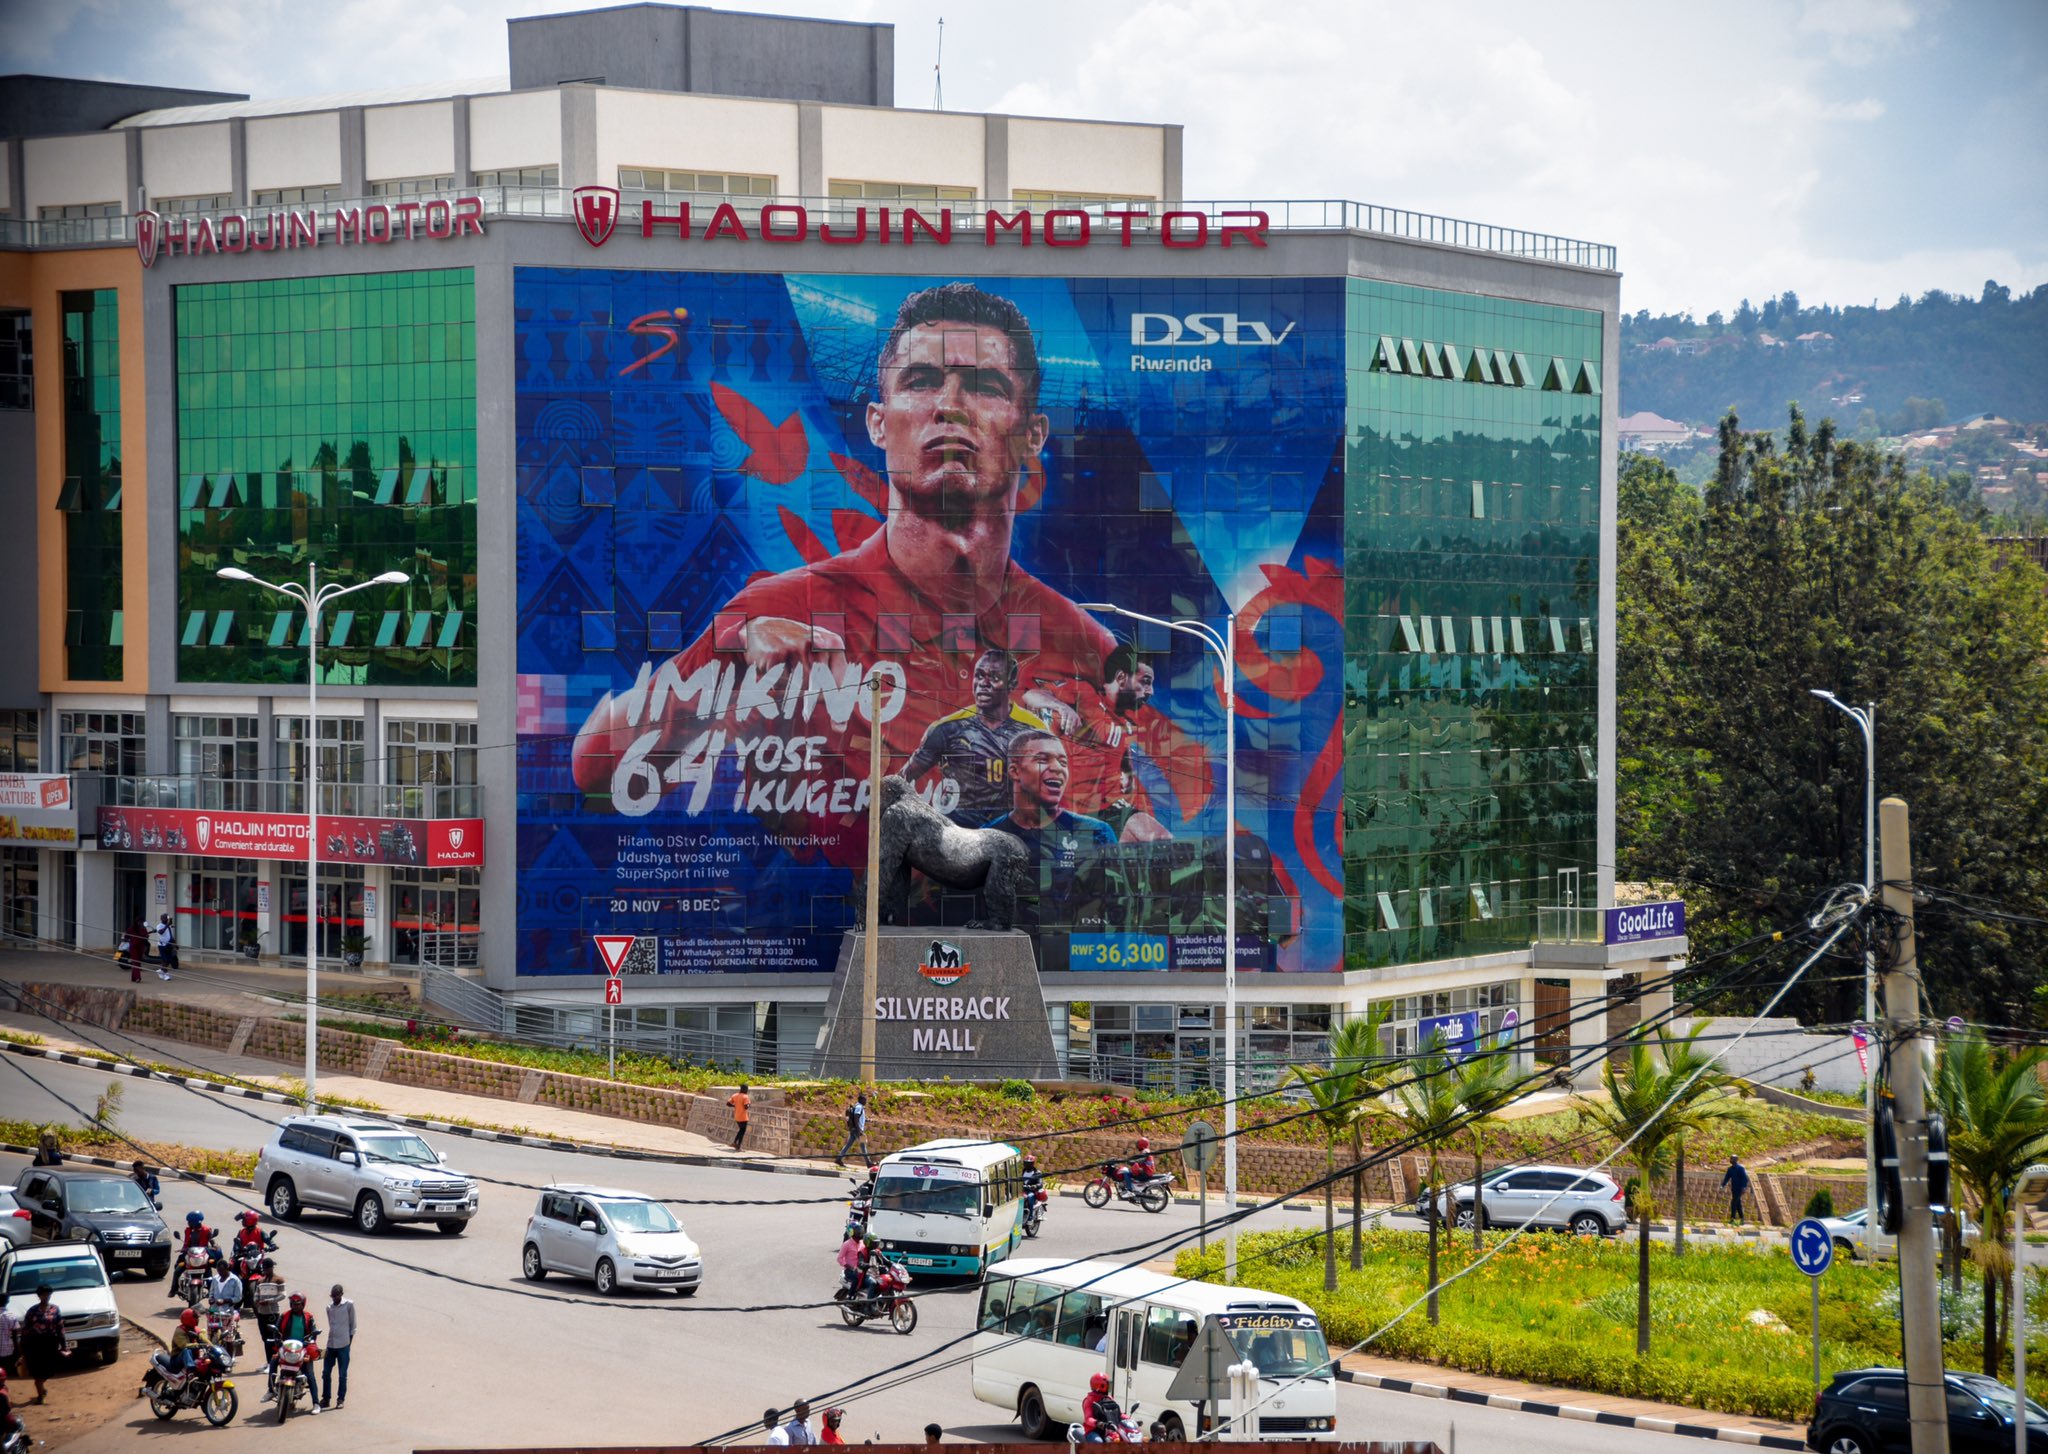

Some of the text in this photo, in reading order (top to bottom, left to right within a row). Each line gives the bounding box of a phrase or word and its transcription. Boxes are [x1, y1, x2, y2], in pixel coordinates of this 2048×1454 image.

[165, 209, 318, 257] HAOJIN
[335, 196, 485, 245] MOTOR
[641, 200, 951, 246] HAOJIN
[984, 209, 1270, 248] MOTOR
[1131, 313, 1296, 345] DStv
[1131, 355, 1212, 372] Rwanda
[627, 660, 906, 728] IMIKINO
[735, 735, 827, 773] YOSE
[611, 729, 727, 817] 64
[986, 758, 1003, 783] 10
[46, 789, 64, 804] OPEN
[214, 821, 264, 836] HAOJIN
[215, 839, 294, 853] Convenient and durable
[618, 834, 841, 849] Hitamo DStv Compact, Ntimucikwe!
[437, 851, 476, 859] HAOJIN
[617, 851, 741, 866] Udushya twose kuri
[616, 867, 730, 881] SuperSport ni live
[610, 900, 628, 912] 20
[632, 900, 661, 912] NOV
[677, 899, 690, 911] 18
[693, 899, 721, 911] DEC
[1618, 905, 1674, 934] GoodLife
[787, 938, 806, 946] 1111
[1175, 935, 1207, 944] Includes
[1208, 935, 1223, 943] Full
[664, 949, 676, 957] Tel
[725, 948, 745, 956] +250
[1071, 943, 1165, 967] RWF 36,300
[1182, 947, 1207, 955] month
[1207, 947, 1225, 955] DStv
[664, 959, 692, 967] TUNGA
[1176, 957, 1222, 967] subscription
[875, 996, 1011, 1020] SILVERBACK
[912, 1028, 976, 1051] MALL
[961, 1171, 972, 1179] 103
[1234, 1315, 1294, 1329] Fidelity
